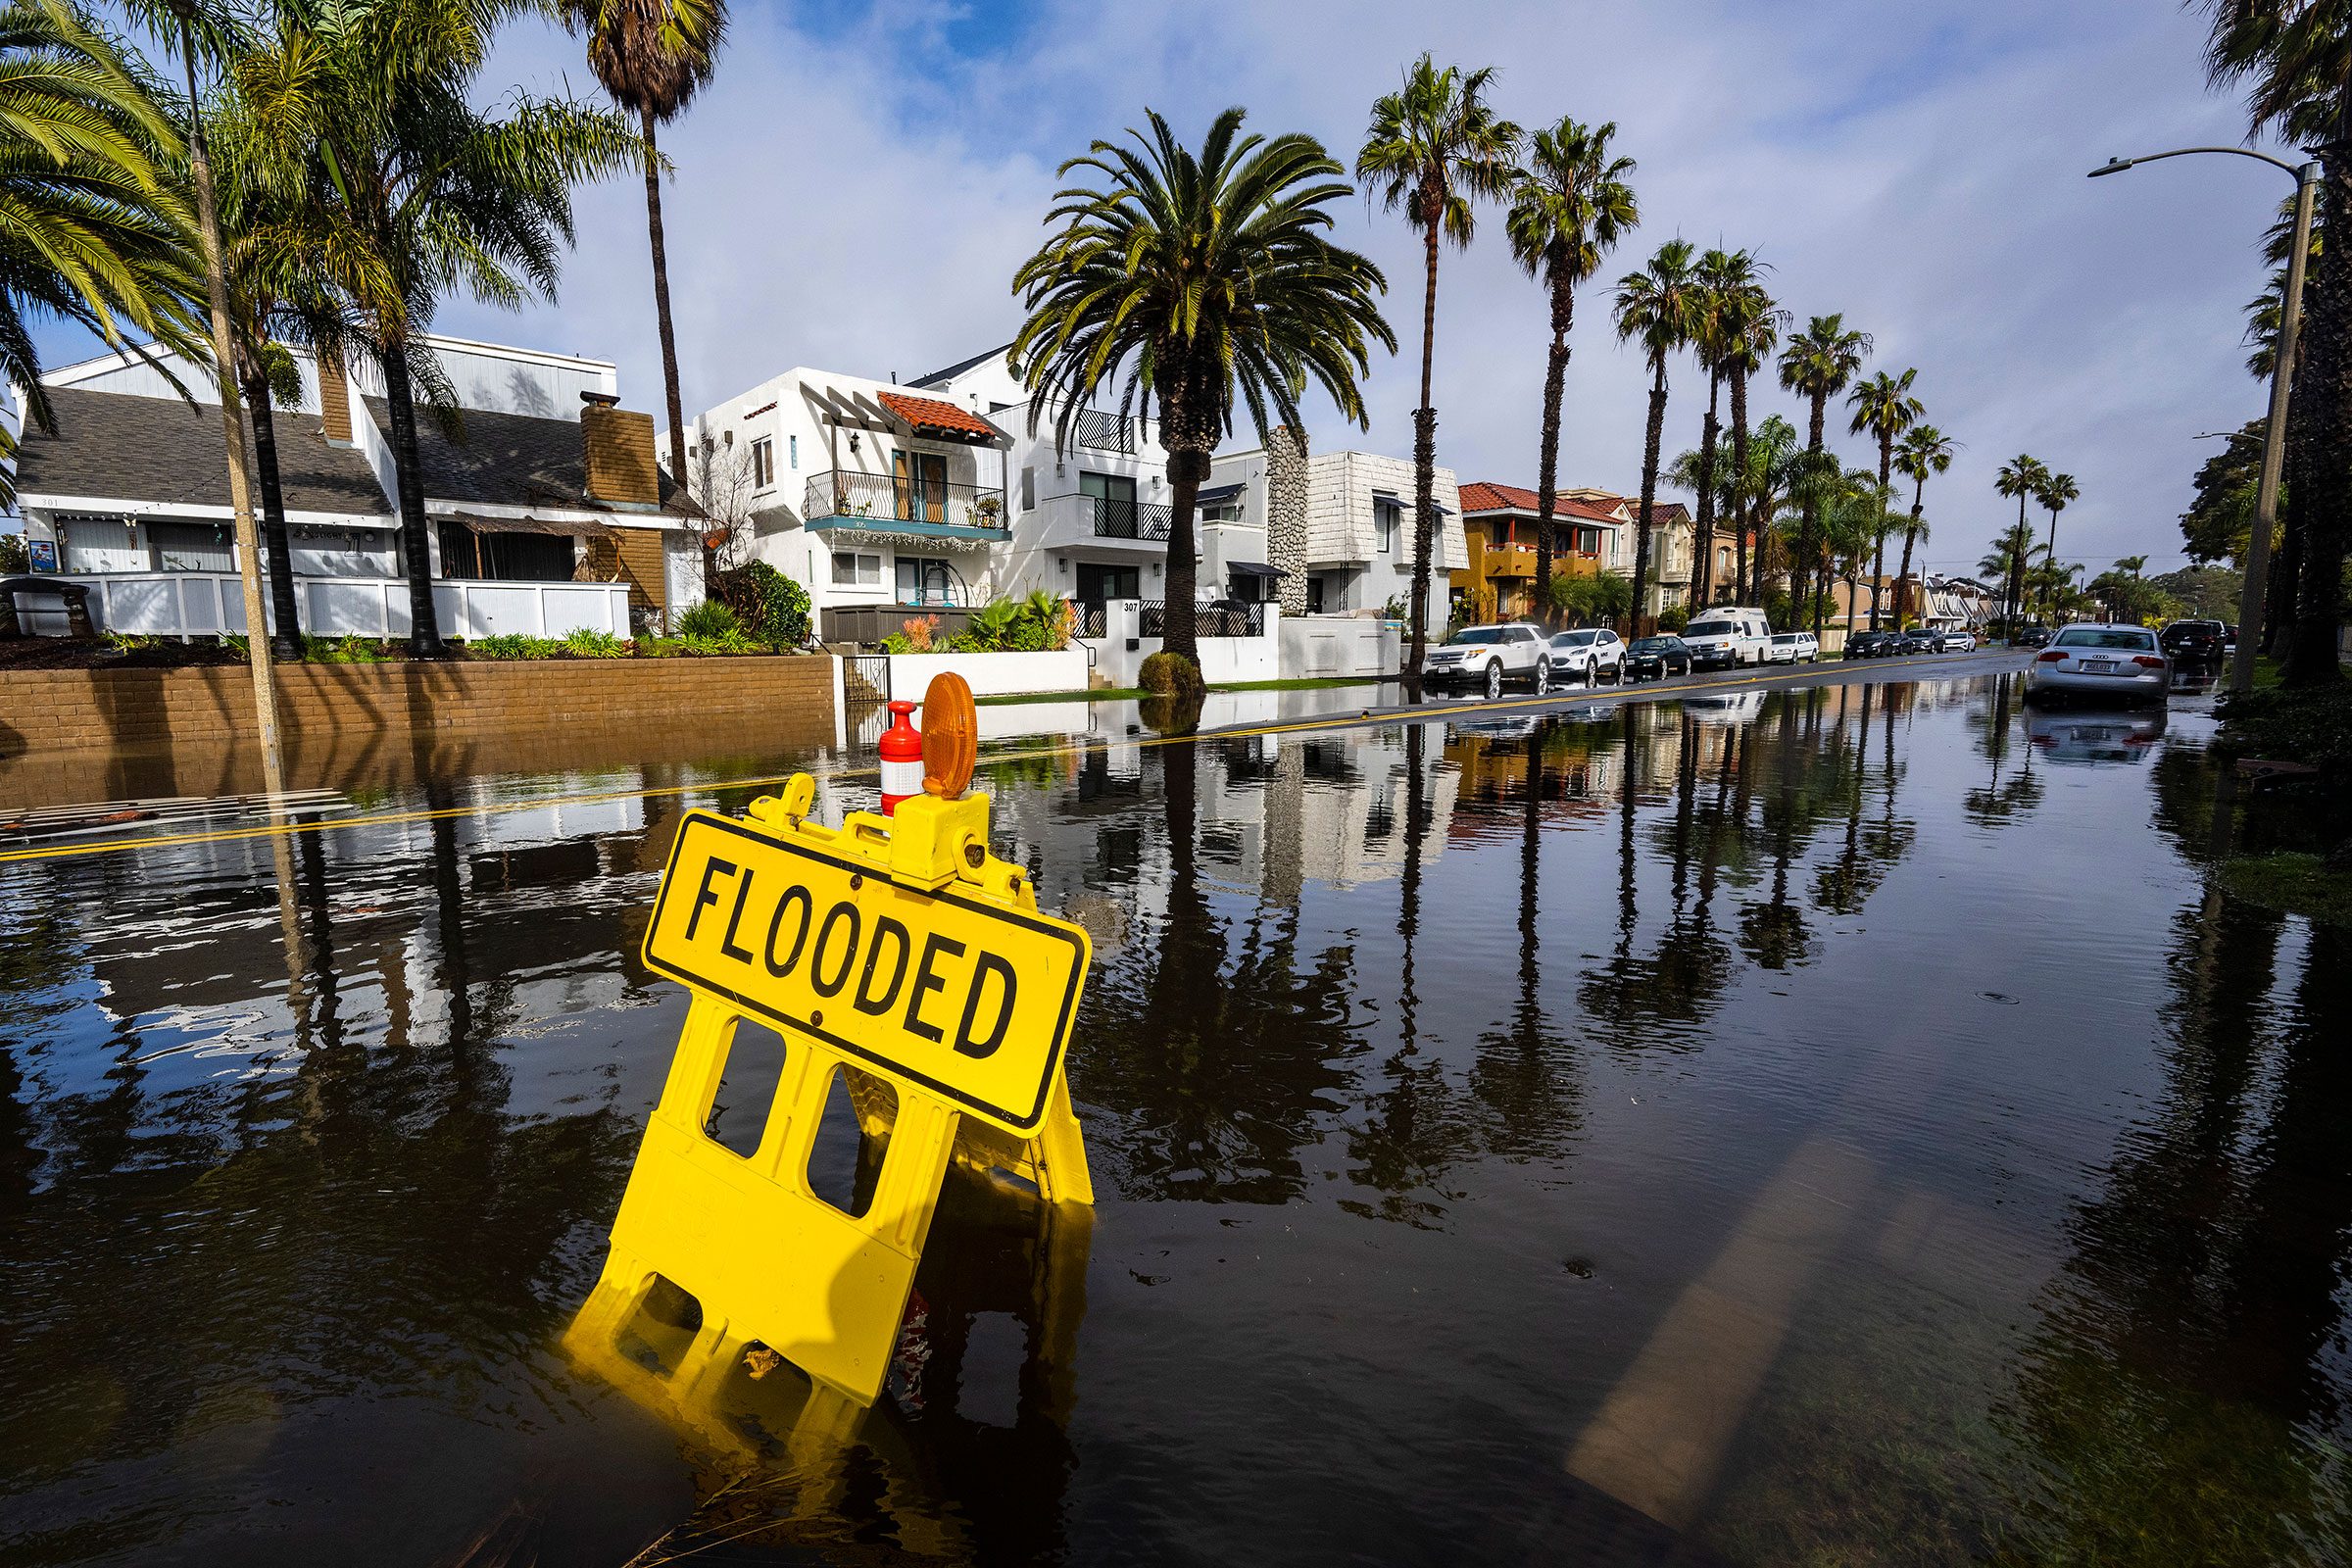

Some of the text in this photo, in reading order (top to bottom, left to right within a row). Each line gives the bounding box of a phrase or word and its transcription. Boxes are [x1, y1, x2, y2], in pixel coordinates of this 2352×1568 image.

[41, 498, 59, 507] 301
[1124, 603, 1138, 612] 307
[685, 856, 1017, 1059] FLOODED
